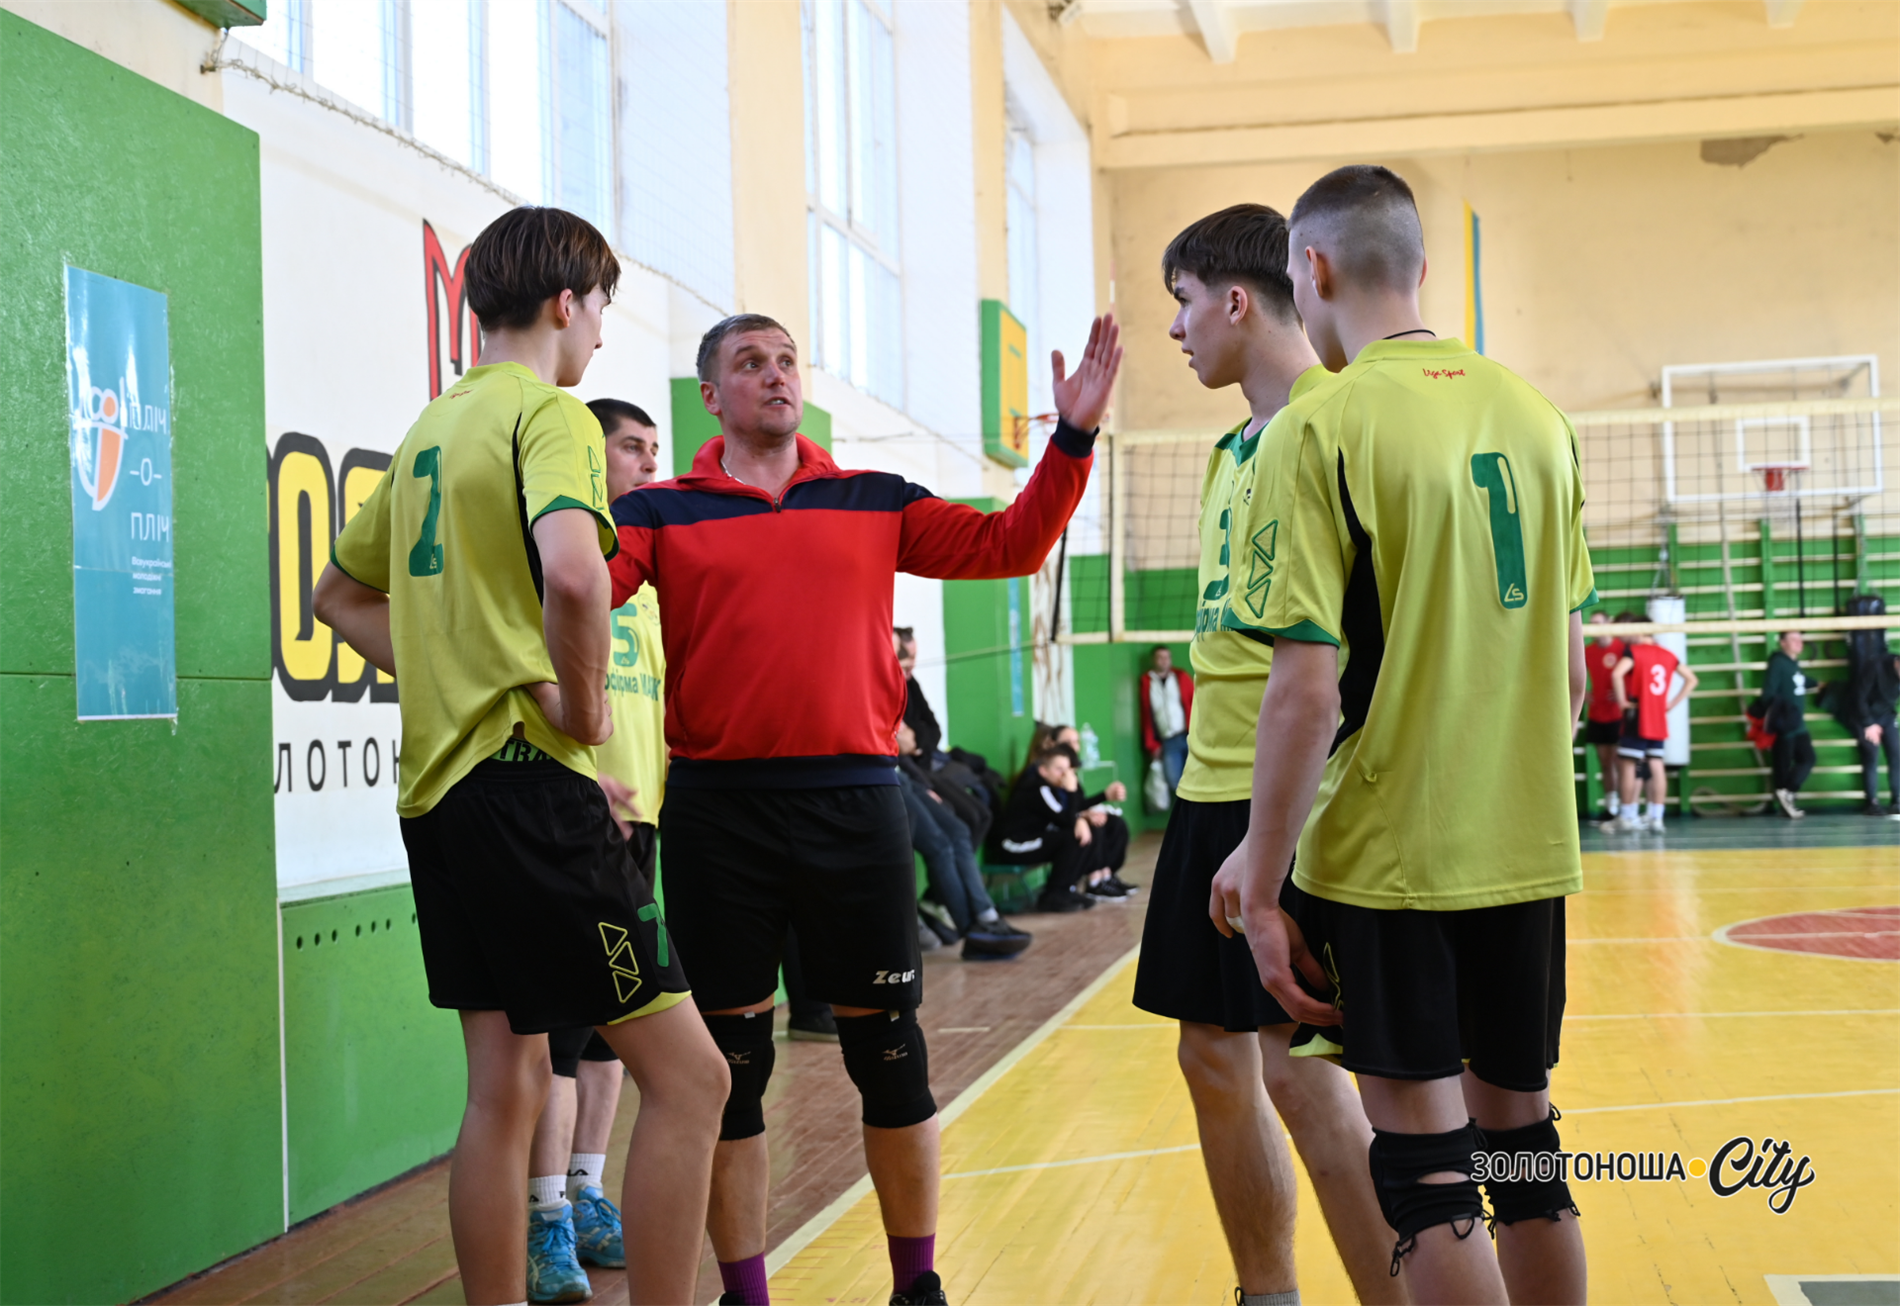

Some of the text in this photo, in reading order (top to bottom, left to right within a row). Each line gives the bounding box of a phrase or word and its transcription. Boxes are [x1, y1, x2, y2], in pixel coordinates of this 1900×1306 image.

[131, 511, 169, 543] ПЛІЧ
[1470, 451, 1528, 610] 1
[610, 602, 640, 667] 5
[1649, 664, 1667, 696] 3
